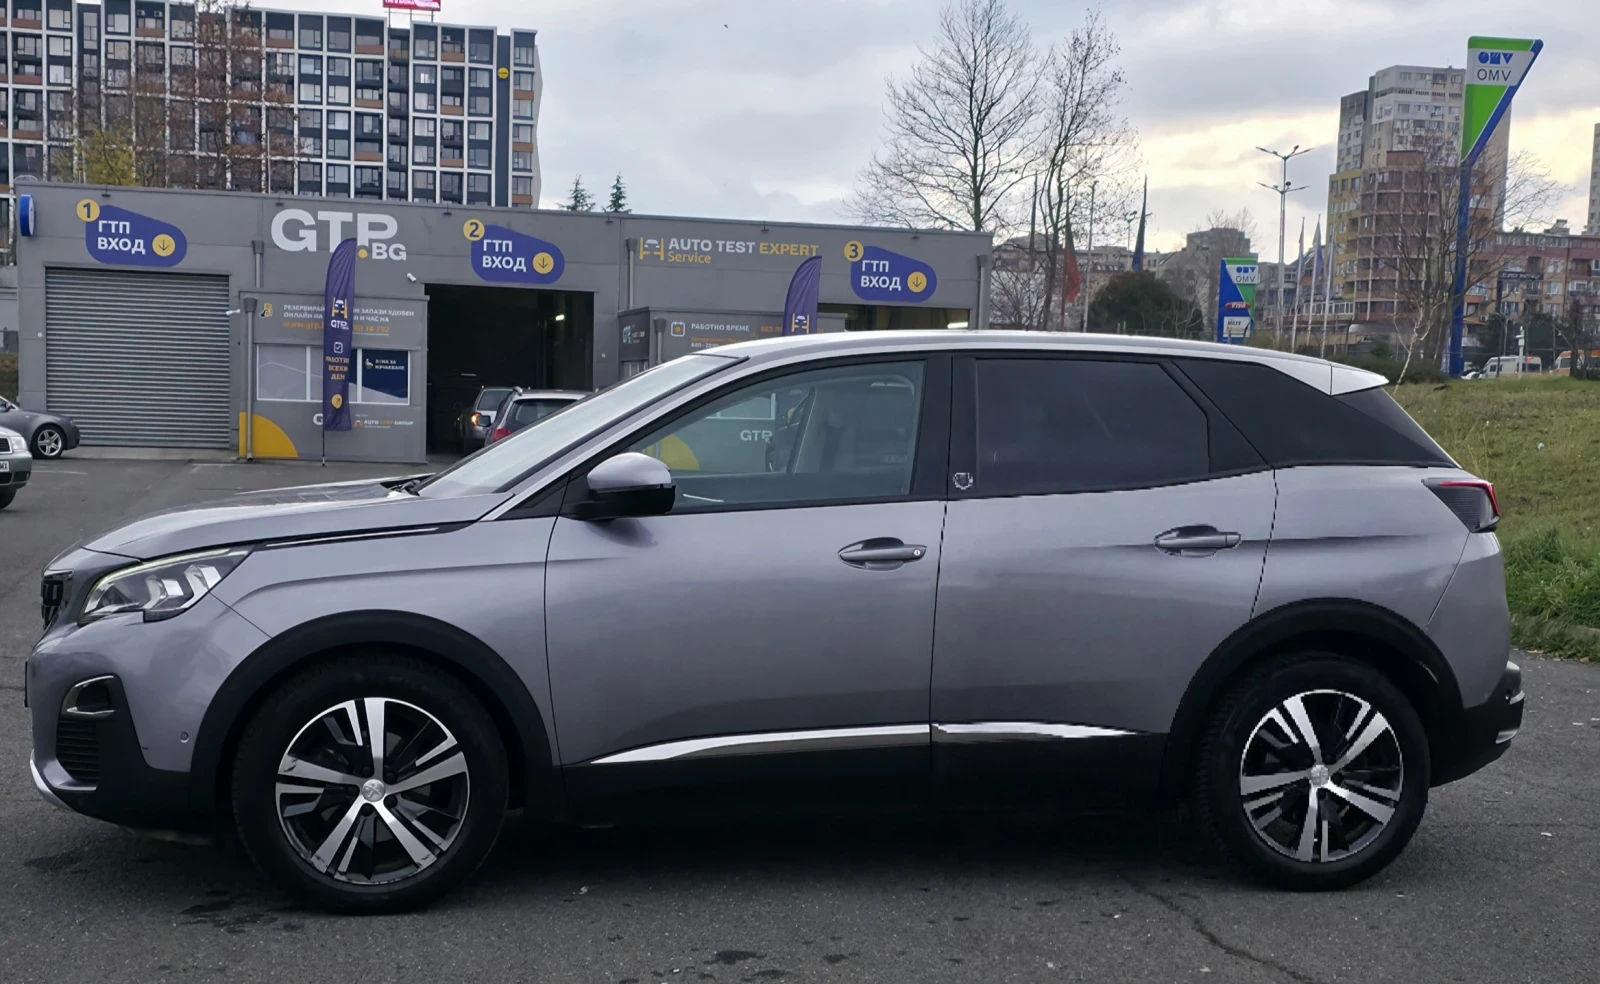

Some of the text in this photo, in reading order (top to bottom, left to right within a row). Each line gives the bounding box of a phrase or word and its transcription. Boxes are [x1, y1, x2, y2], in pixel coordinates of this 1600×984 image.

[1477, 68, 1511, 81] OMV
[83, 202, 91, 219] 1
[98, 220, 130, 234] ГТП
[270, 208, 398, 253] GTP
[469, 221, 480, 238] 2
[97, 236, 146, 255] ВХОД
[483, 239, 513, 253] ГТП
[668, 238, 819, 256] AUTO TEST EXPERT
[849, 243, 859, 259] 3
[482, 255, 527, 273] ВХОД
[667, 252, 711, 264] Service
[862, 259, 889, 273] ГТП
[860, 275, 902, 291] ВХОД
[1235, 275, 1256, 283] OMV
[283, 311, 312, 319] ОНЛАЙН
[330, 319, 348, 329] GTP
[691, 323, 725, 331] РАБОТНО
[740, 429, 773, 442] GTP
